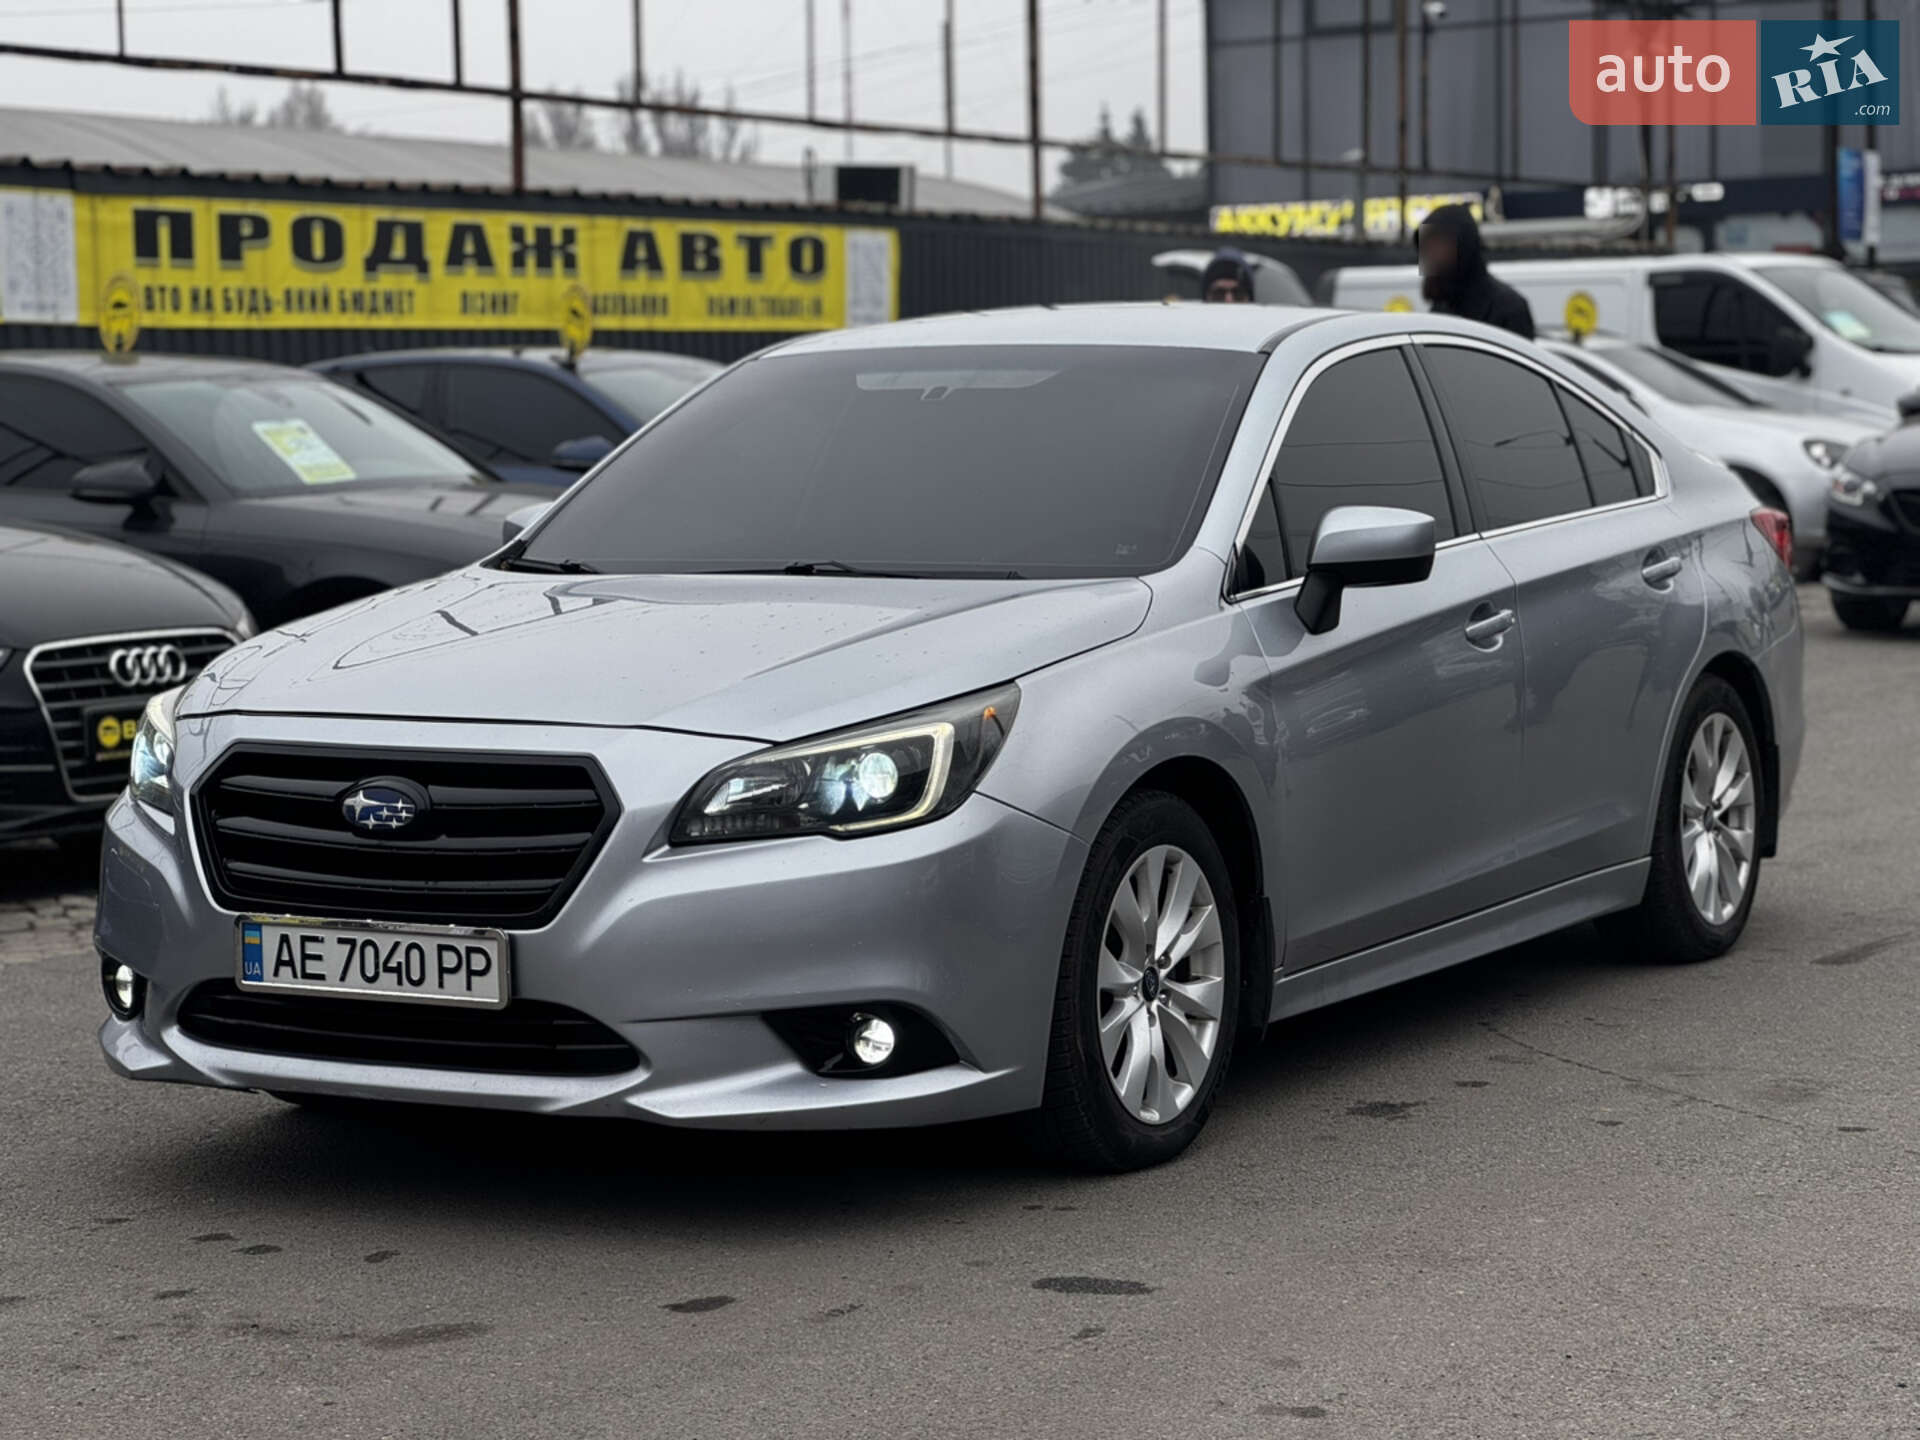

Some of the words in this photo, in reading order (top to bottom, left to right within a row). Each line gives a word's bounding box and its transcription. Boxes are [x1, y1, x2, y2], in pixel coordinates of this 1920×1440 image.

[132, 208, 578, 276] ПРОДАЖ
[620, 229, 826, 279] АВТО
[244, 961, 262, 977] UA
[272, 933, 327, 982] AE
[336, 936, 426, 988] 7040
[436, 943, 493, 992] PP
